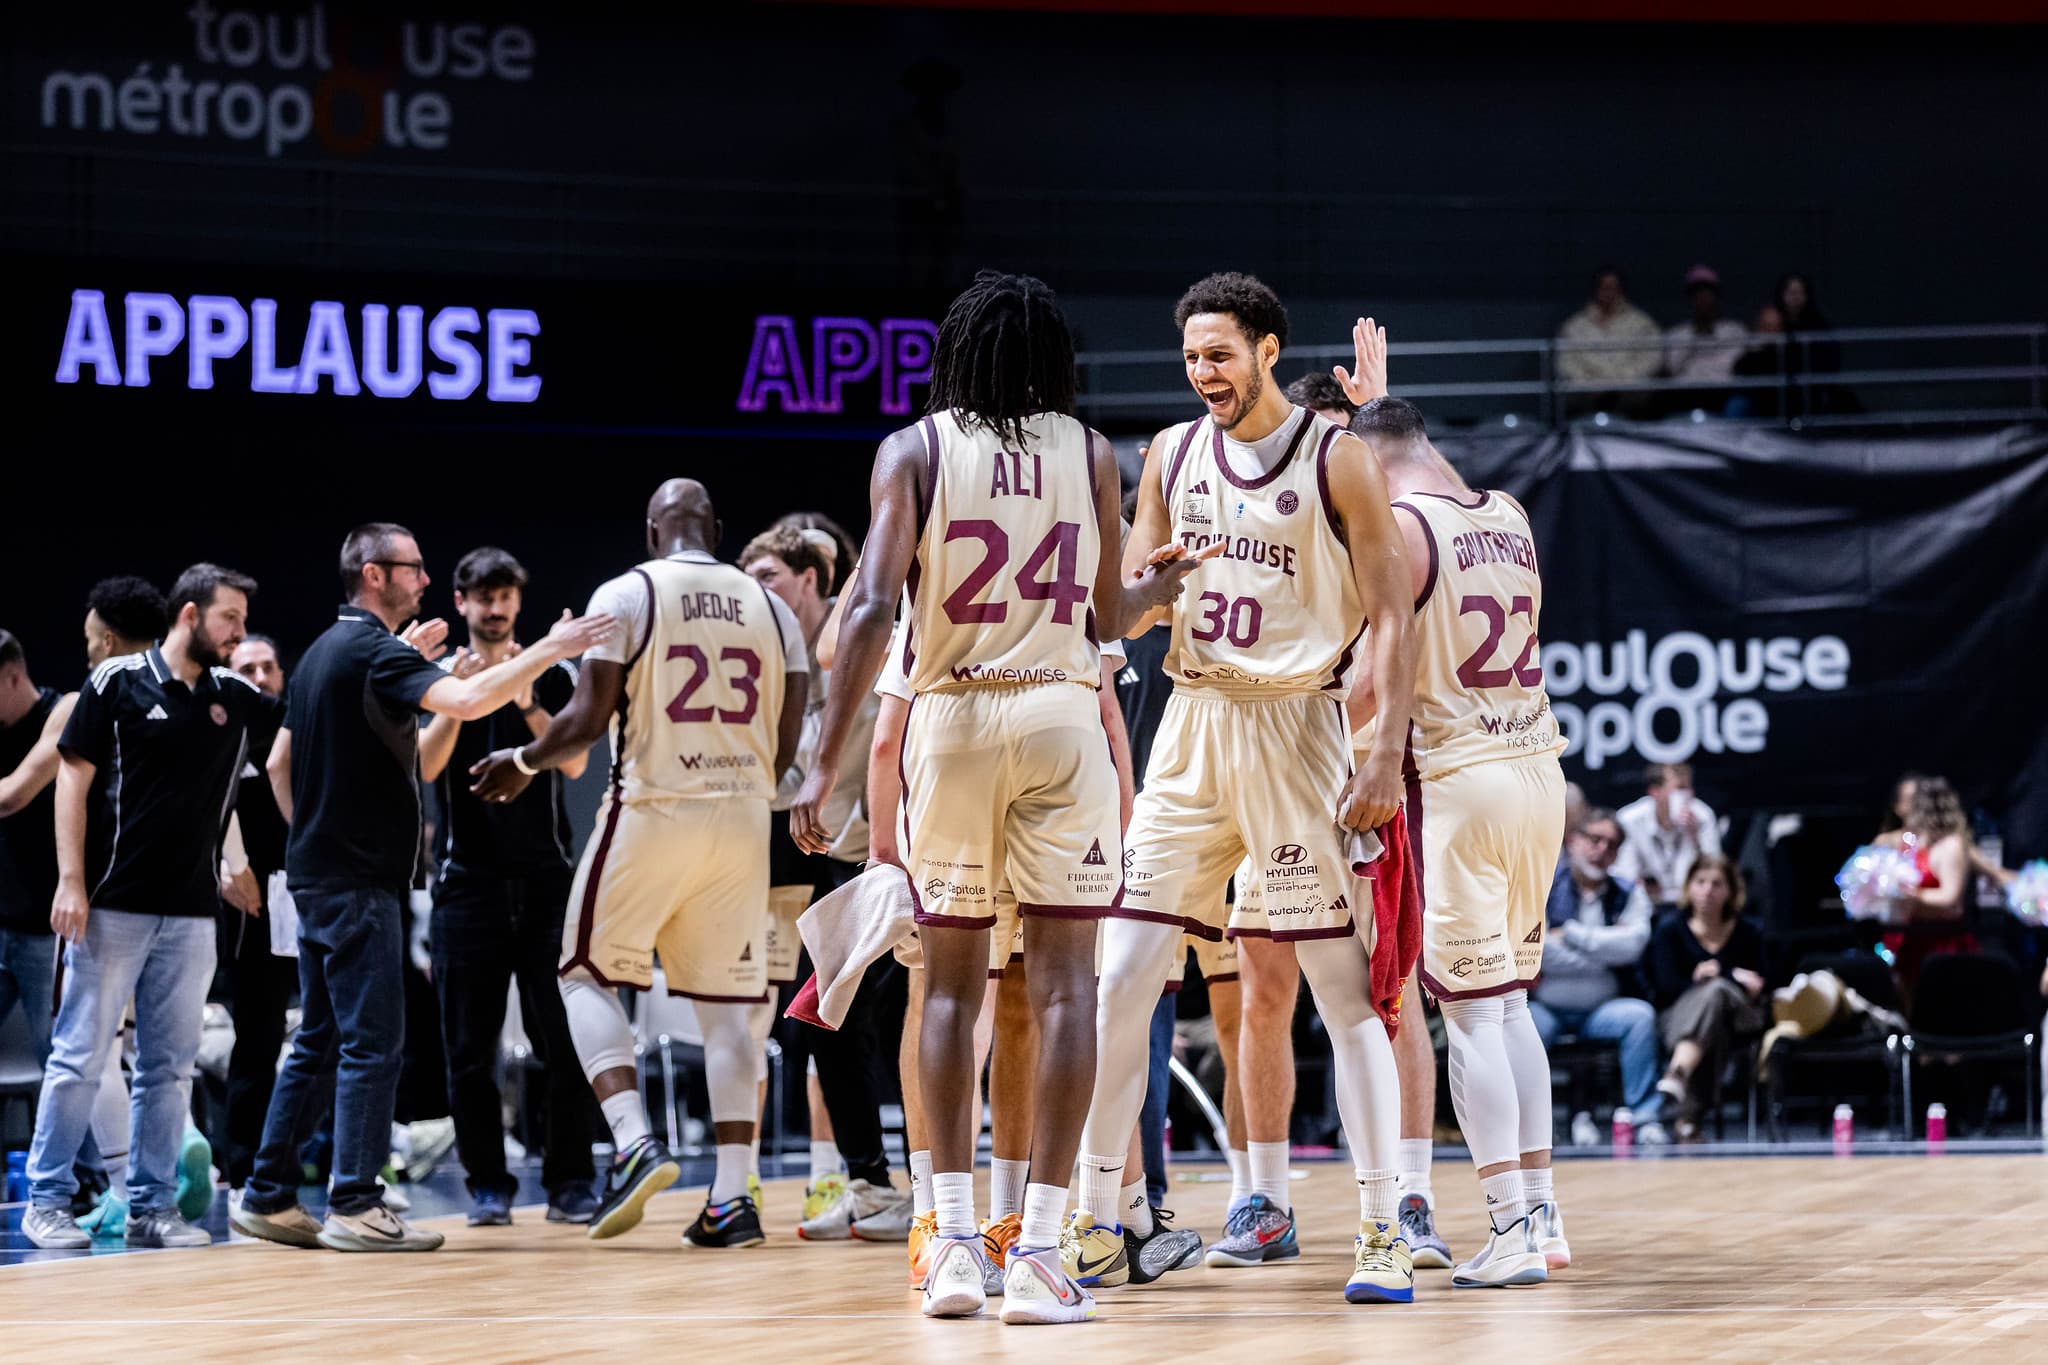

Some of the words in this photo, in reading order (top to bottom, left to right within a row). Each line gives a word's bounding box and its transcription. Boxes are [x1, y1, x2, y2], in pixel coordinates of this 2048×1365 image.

[55, 288, 543, 403] APPLAUSE
[735, 313, 938, 415] APP
[990, 451, 1042, 501] ALI
[942, 519, 1090, 625] 24
[1453, 530, 1536, 574] GAUTHIER
[681, 592, 745, 627] DJEDJE
[1191, 590, 1263, 649] 30
[1455, 595, 1543, 689] 22
[664, 644, 761, 725] 23
[948, 881, 986, 896] Capitole
[1067, 872, 1115, 882] FIDUCIAIRE
[1266, 864, 1319, 879] HYUNDAI
[1267, 881, 1320, 893] Delahaye
[1268, 905, 1315, 917] autobuy
